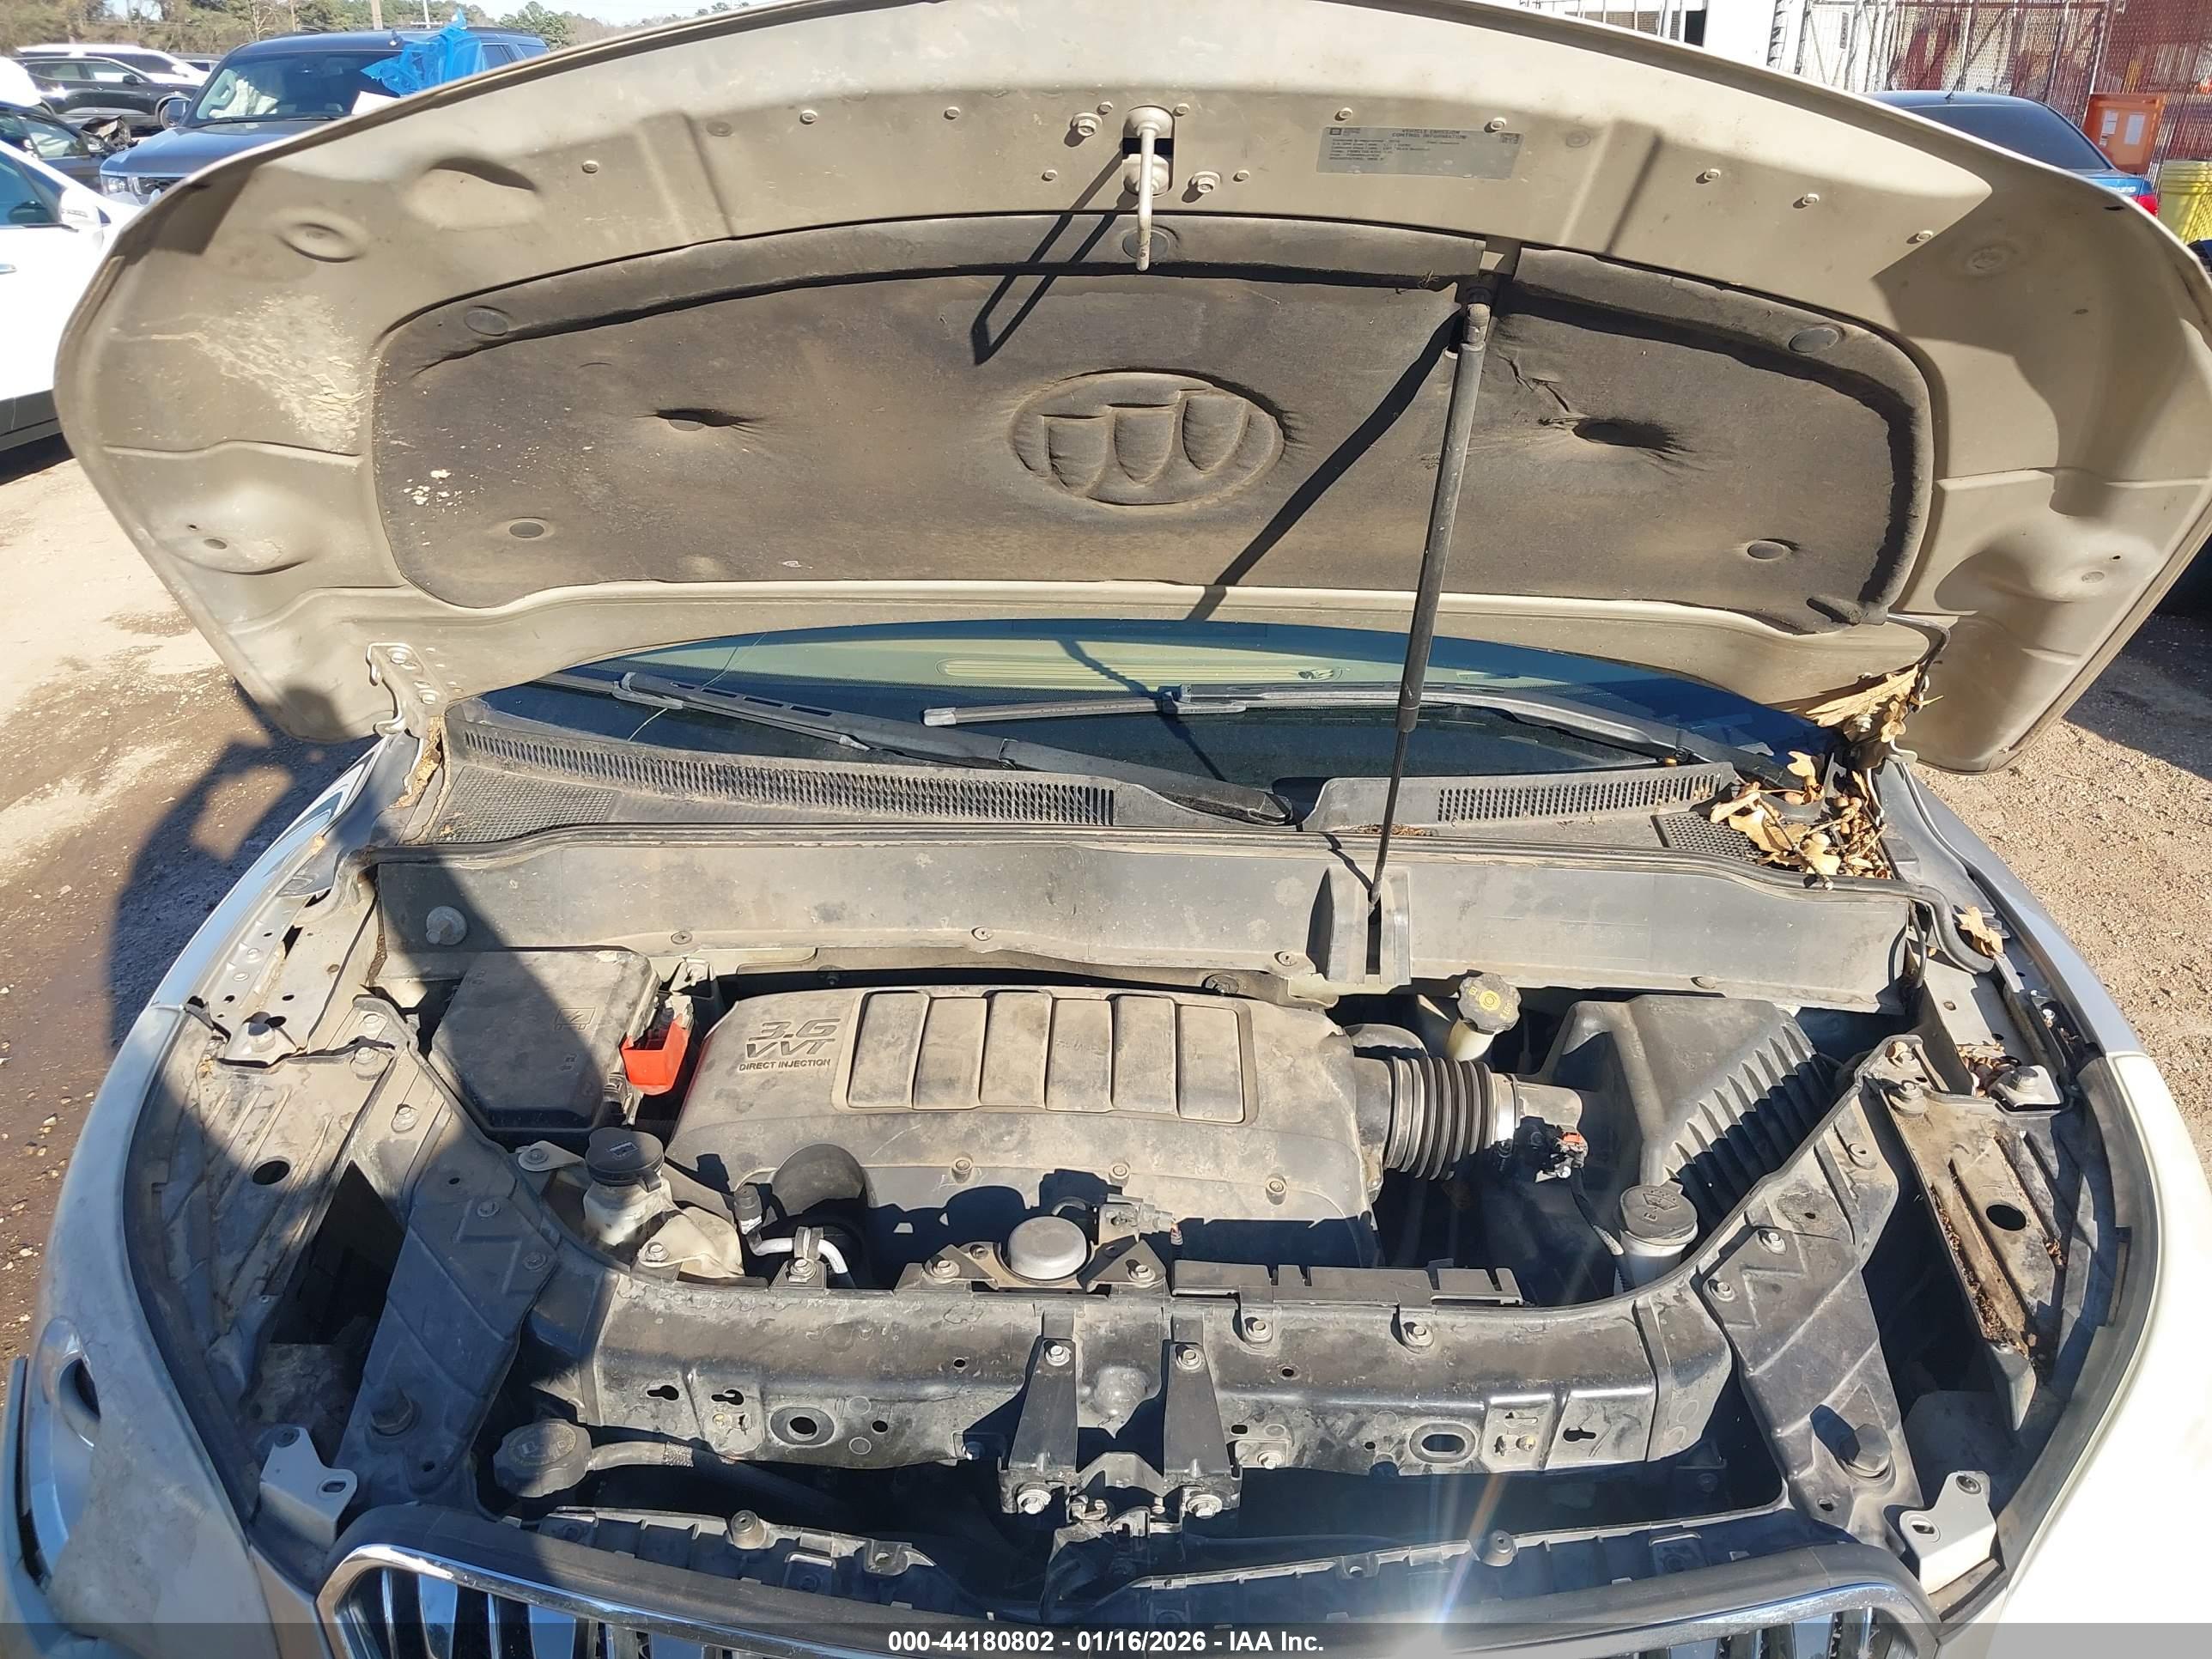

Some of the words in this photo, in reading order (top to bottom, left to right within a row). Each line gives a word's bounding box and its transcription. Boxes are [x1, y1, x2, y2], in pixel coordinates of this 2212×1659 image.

[749, 1018, 842, 1042] 3.6
[746, 1038, 836, 1058] VVT
[739, 1061, 776, 1071] DIRECT
[778, 1059, 830, 1068] INJECTION
